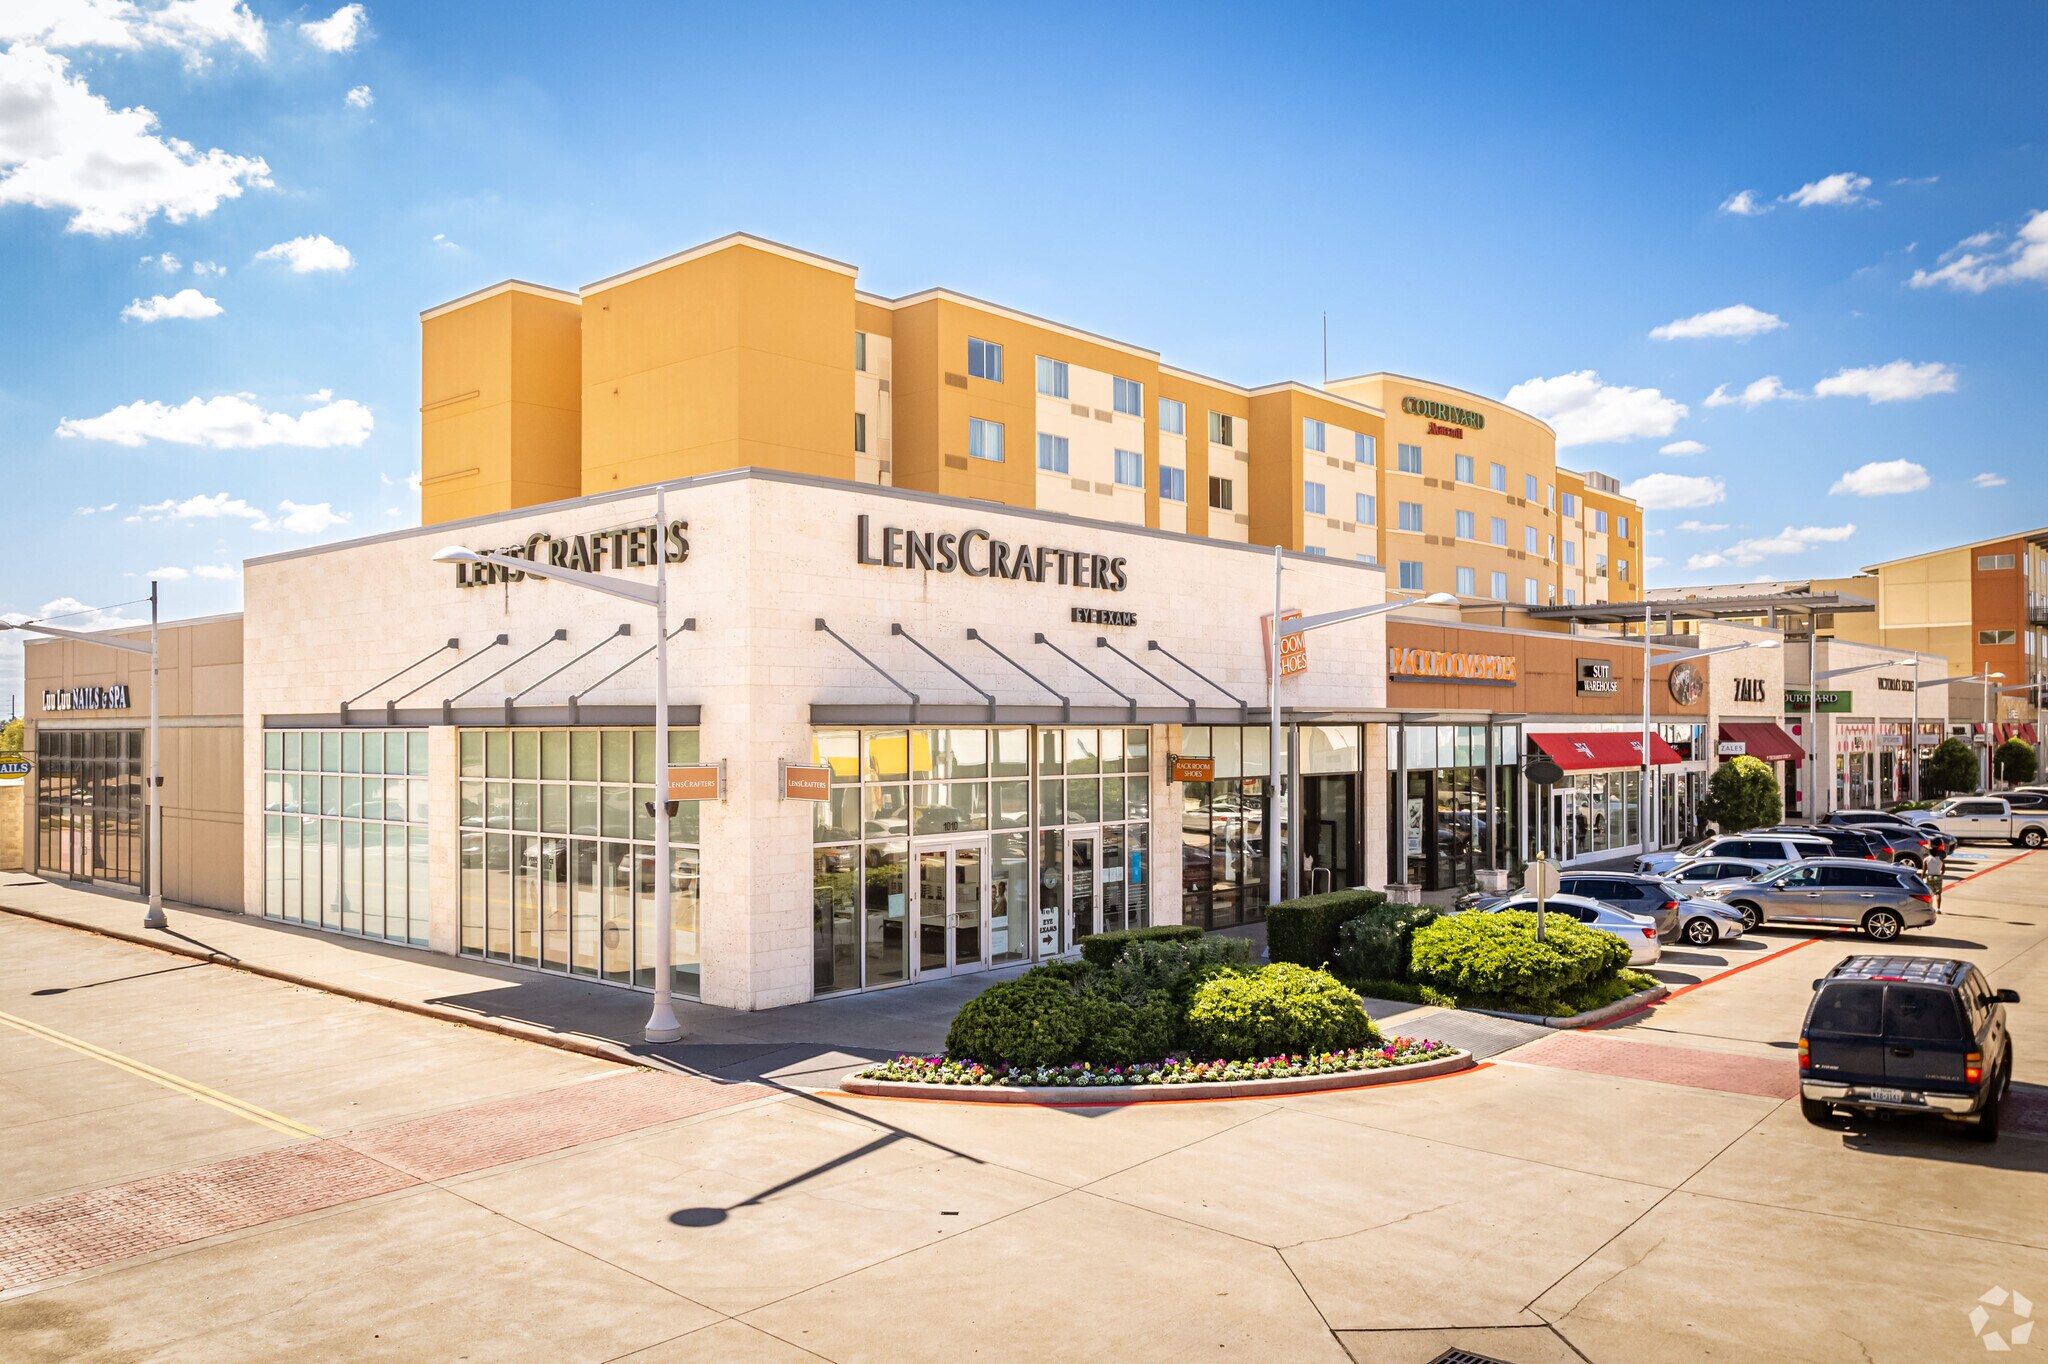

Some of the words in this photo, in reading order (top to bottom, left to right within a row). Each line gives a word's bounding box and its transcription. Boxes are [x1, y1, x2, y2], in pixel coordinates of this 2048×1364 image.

[1402, 397, 1485, 430] COURTYARD
[857, 514, 1128, 591] LENSCRAFTERS
[1072, 607, 1097, 623] EYE
[1100, 610, 1138, 626] EXAMS
[1280, 634, 1305, 654] OOM
[1390, 647, 1432, 675] RACK
[1433, 651, 1475, 678] ROOM
[1476, 653, 1517, 681] SHOES
[1593, 665, 1609, 678] SUIT
[1583, 681, 1618, 692] WAREHOUSE
[1734, 677, 1766, 702] ZALES
[1901, 679, 1915, 692] SECRE
[72, 687, 101, 710] NAILS
[109, 685, 128, 709] SPA
[1785, 694, 1838, 703] OURTARD
[0, 763, 29, 773] AILS
[1176, 762, 1192, 770] RACK
[1184, 770, 1203, 778] SHOES
[943, 821, 959, 832] 1010
[1043, 918, 1054, 926] EYE
